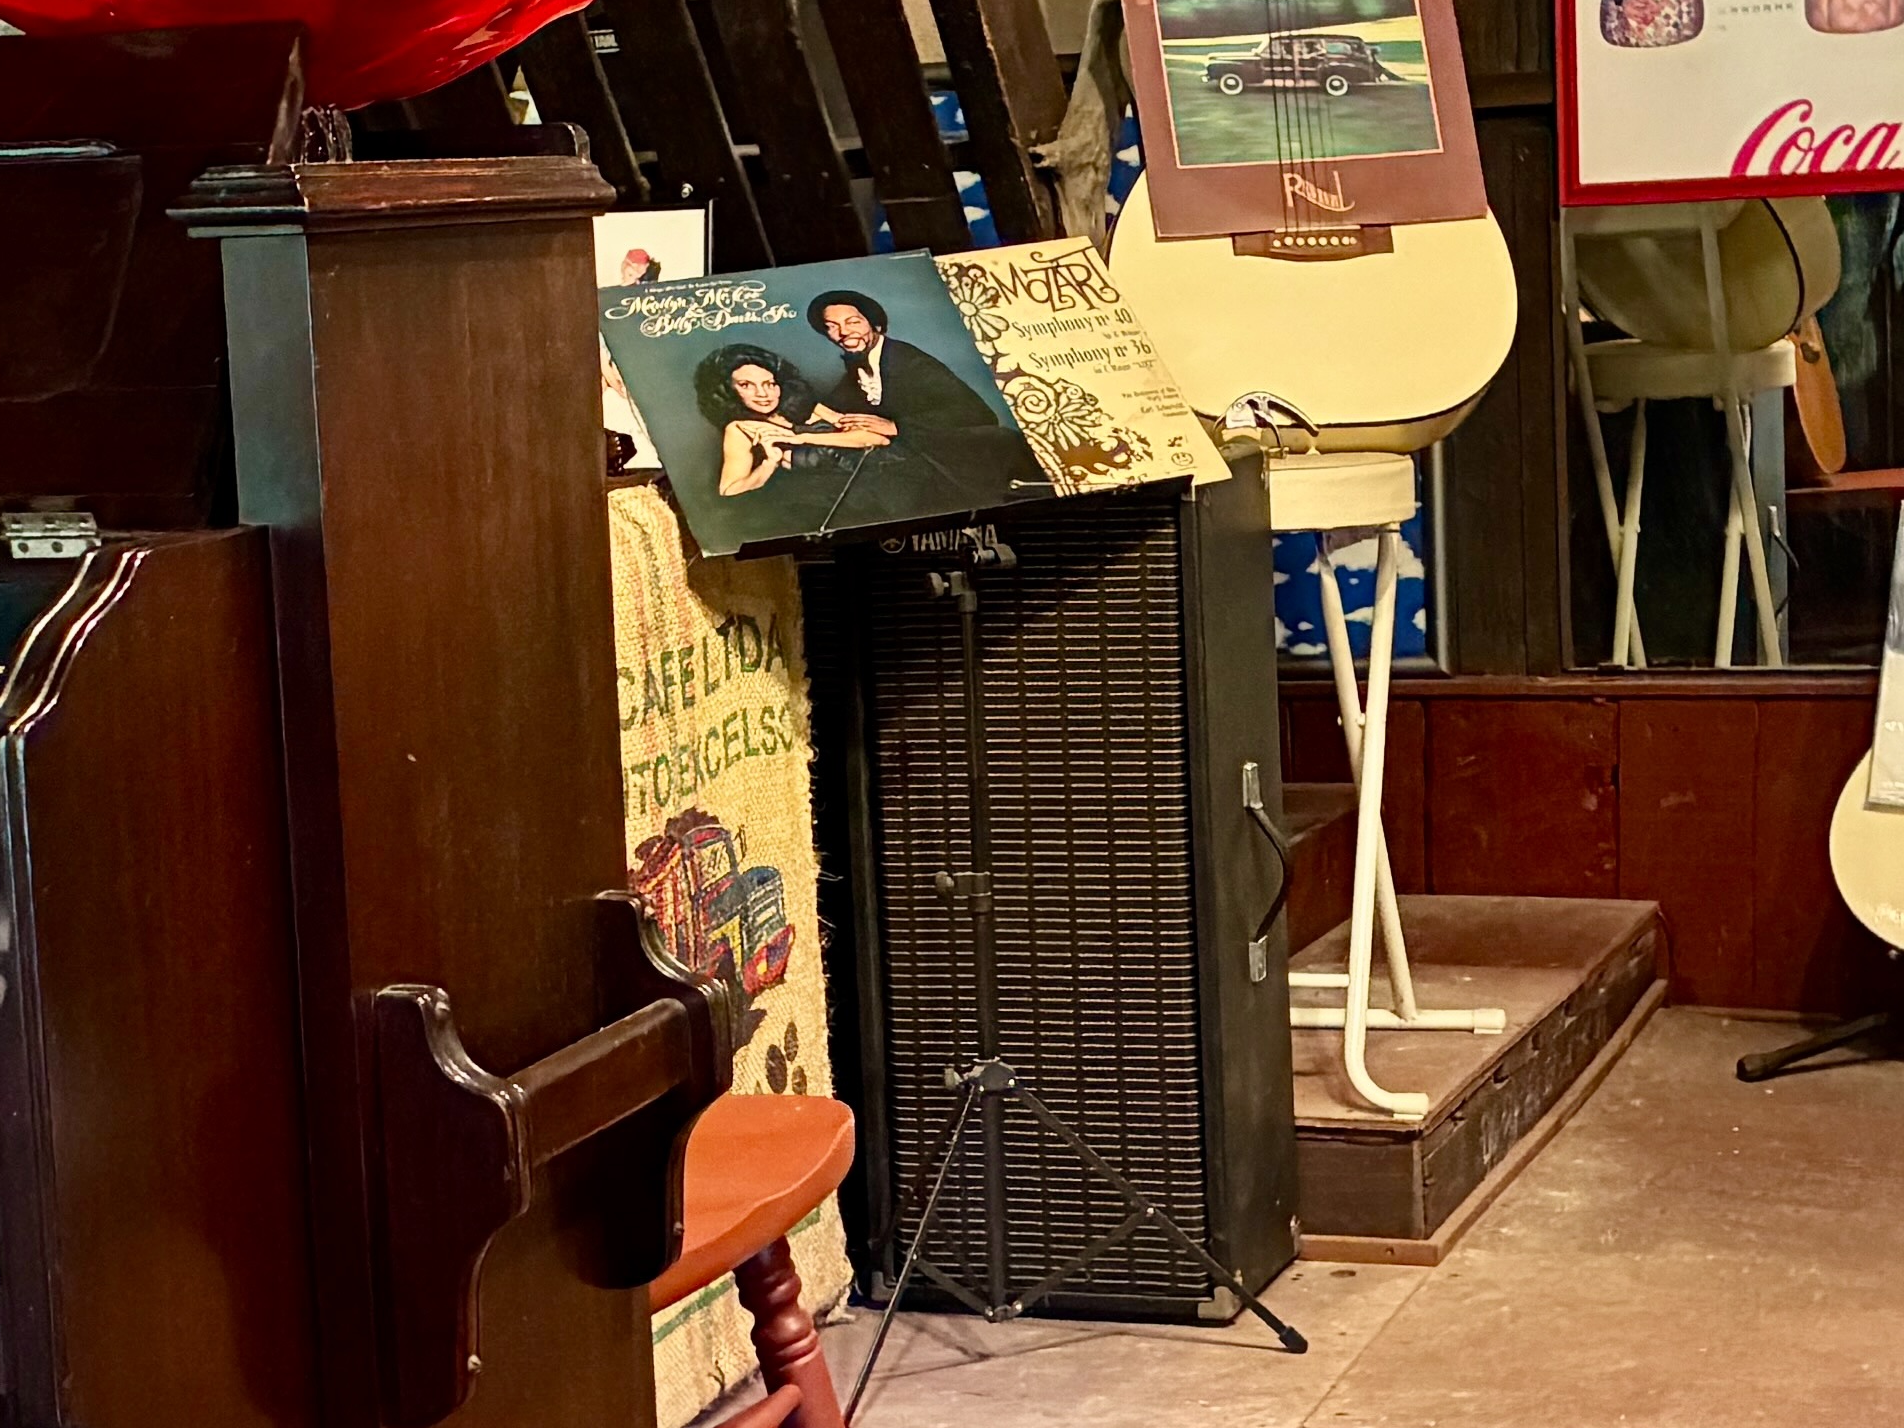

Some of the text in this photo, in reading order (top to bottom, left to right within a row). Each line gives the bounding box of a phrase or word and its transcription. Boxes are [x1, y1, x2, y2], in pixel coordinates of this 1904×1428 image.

[990, 245, 1121, 312] MOZART
[1011, 314, 1092, 342] Symphony
[1113, 307, 1133, 324] 40
[1028, 347, 1112, 373] Symphony
[1129, 338, 1152, 355] 36
[702, 610, 789, 698] LTDA
